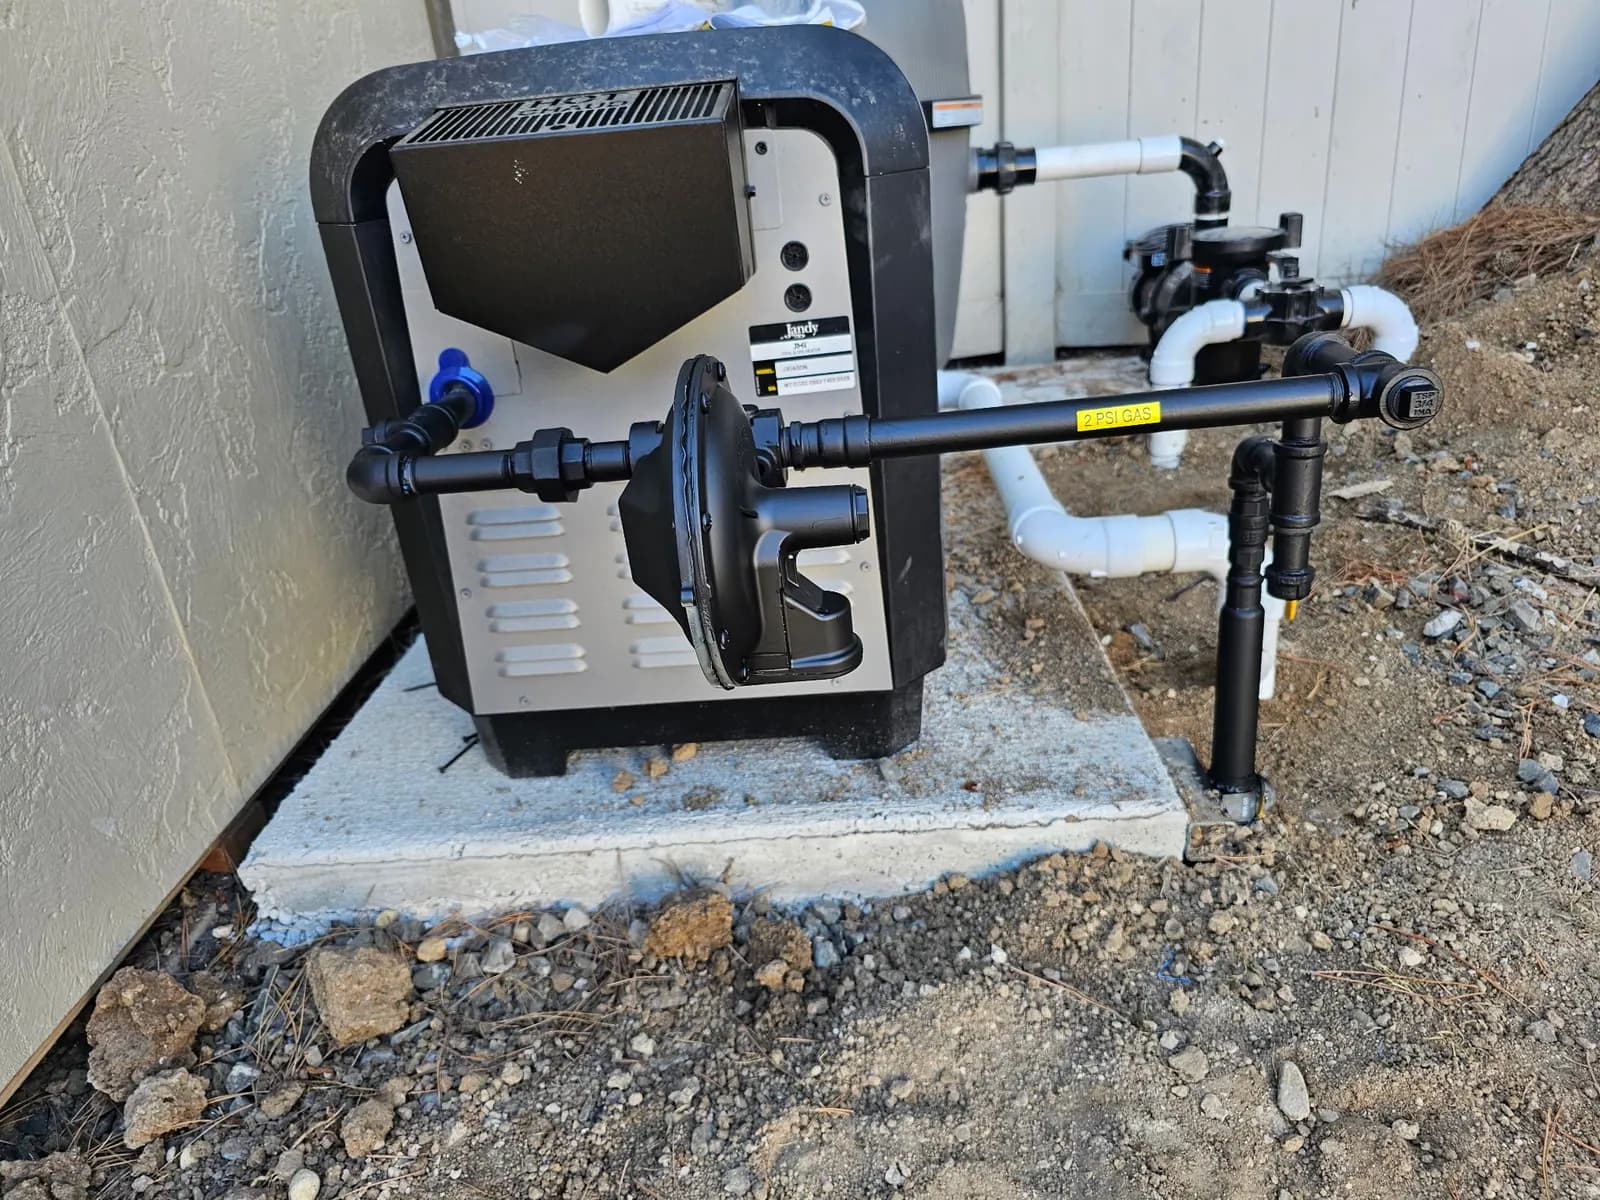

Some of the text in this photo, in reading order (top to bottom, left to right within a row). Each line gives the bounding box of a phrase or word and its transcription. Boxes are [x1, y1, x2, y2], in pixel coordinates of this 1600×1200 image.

[785, 321, 819, 339] Jandy
[1084, 407, 1152, 427] 2 PSI GAS
